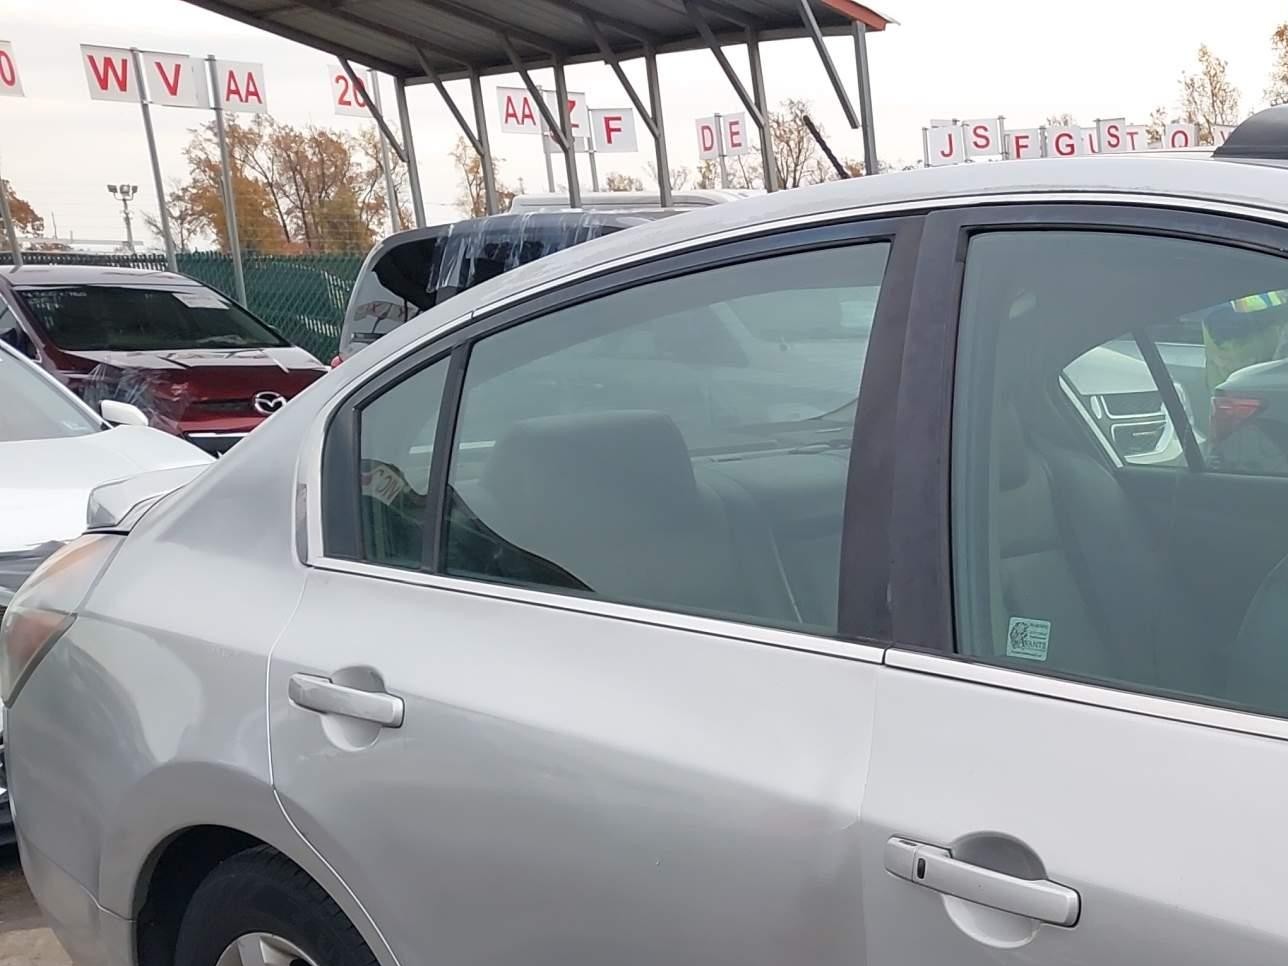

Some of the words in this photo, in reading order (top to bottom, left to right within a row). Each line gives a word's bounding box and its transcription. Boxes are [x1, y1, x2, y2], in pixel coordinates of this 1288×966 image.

[87, 54, 129, 92] W
[154, 62, 182, 97] V
[225, 70, 262, 104] AA
[504, 96, 536, 126] AA
[603, 116, 623, 145] F
[700, 125, 715, 152] D
[728, 121, 743, 148] E
[972, 125, 991, 149] S
[1107, 125, 1120, 148] S
[1126, 131, 1139, 150] T
[940, 133, 953, 158] J
[1014, 135, 1029, 159] F
[1054, 133, 1076, 156] G
